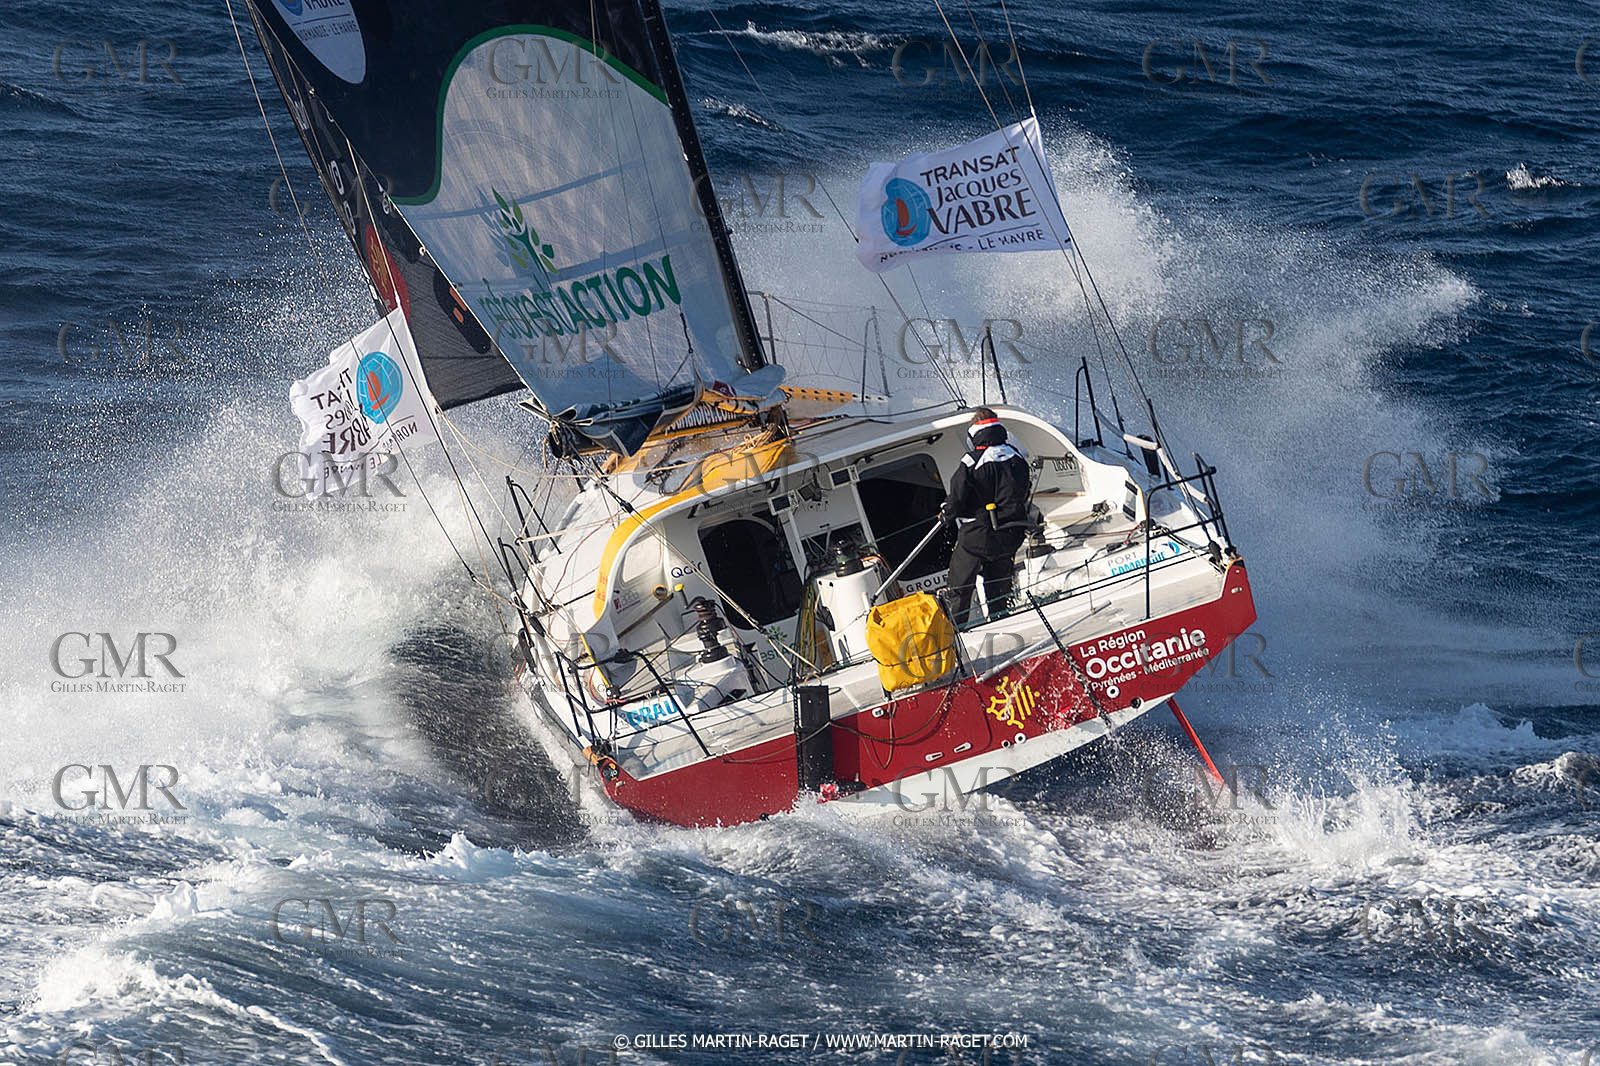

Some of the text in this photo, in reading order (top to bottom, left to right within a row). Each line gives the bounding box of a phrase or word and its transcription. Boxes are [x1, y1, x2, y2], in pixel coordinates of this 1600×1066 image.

[920, 146, 1020, 187] TRANSAT
[936, 168, 1021, 210] Jacques
[926, 187, 1036, 235] VABRE
[1080, 629, 1146, 658] La Région
[1085, 628, 1206, 679] Occitanie
[1091, 671, 1137, 692] Pyrénées
[1144, 647, 1209, 675] Méditerranée
[627, 700, 679, 726] GRAU
